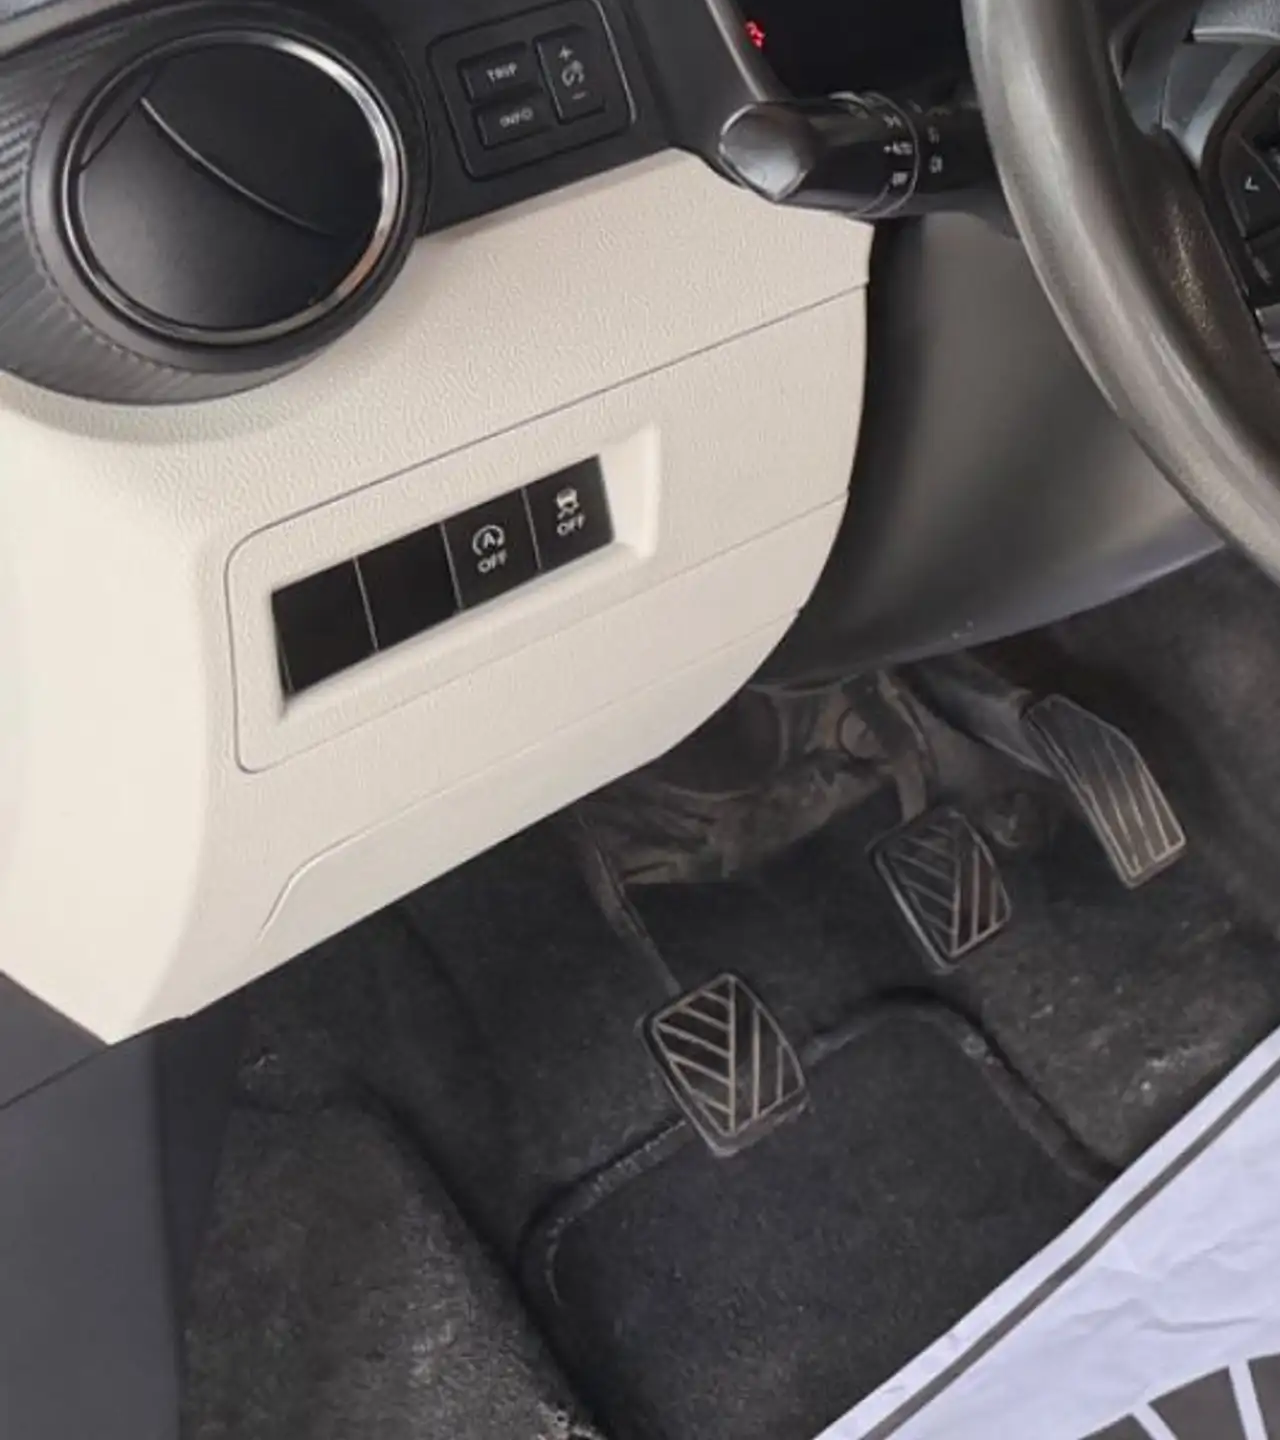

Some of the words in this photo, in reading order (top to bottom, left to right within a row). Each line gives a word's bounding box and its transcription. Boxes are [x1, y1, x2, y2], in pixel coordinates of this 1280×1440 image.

[486, 62, 517, 83] TRIP
[557, 514, 584, 536] OFF
[478, 549, 507, 573] OFF
